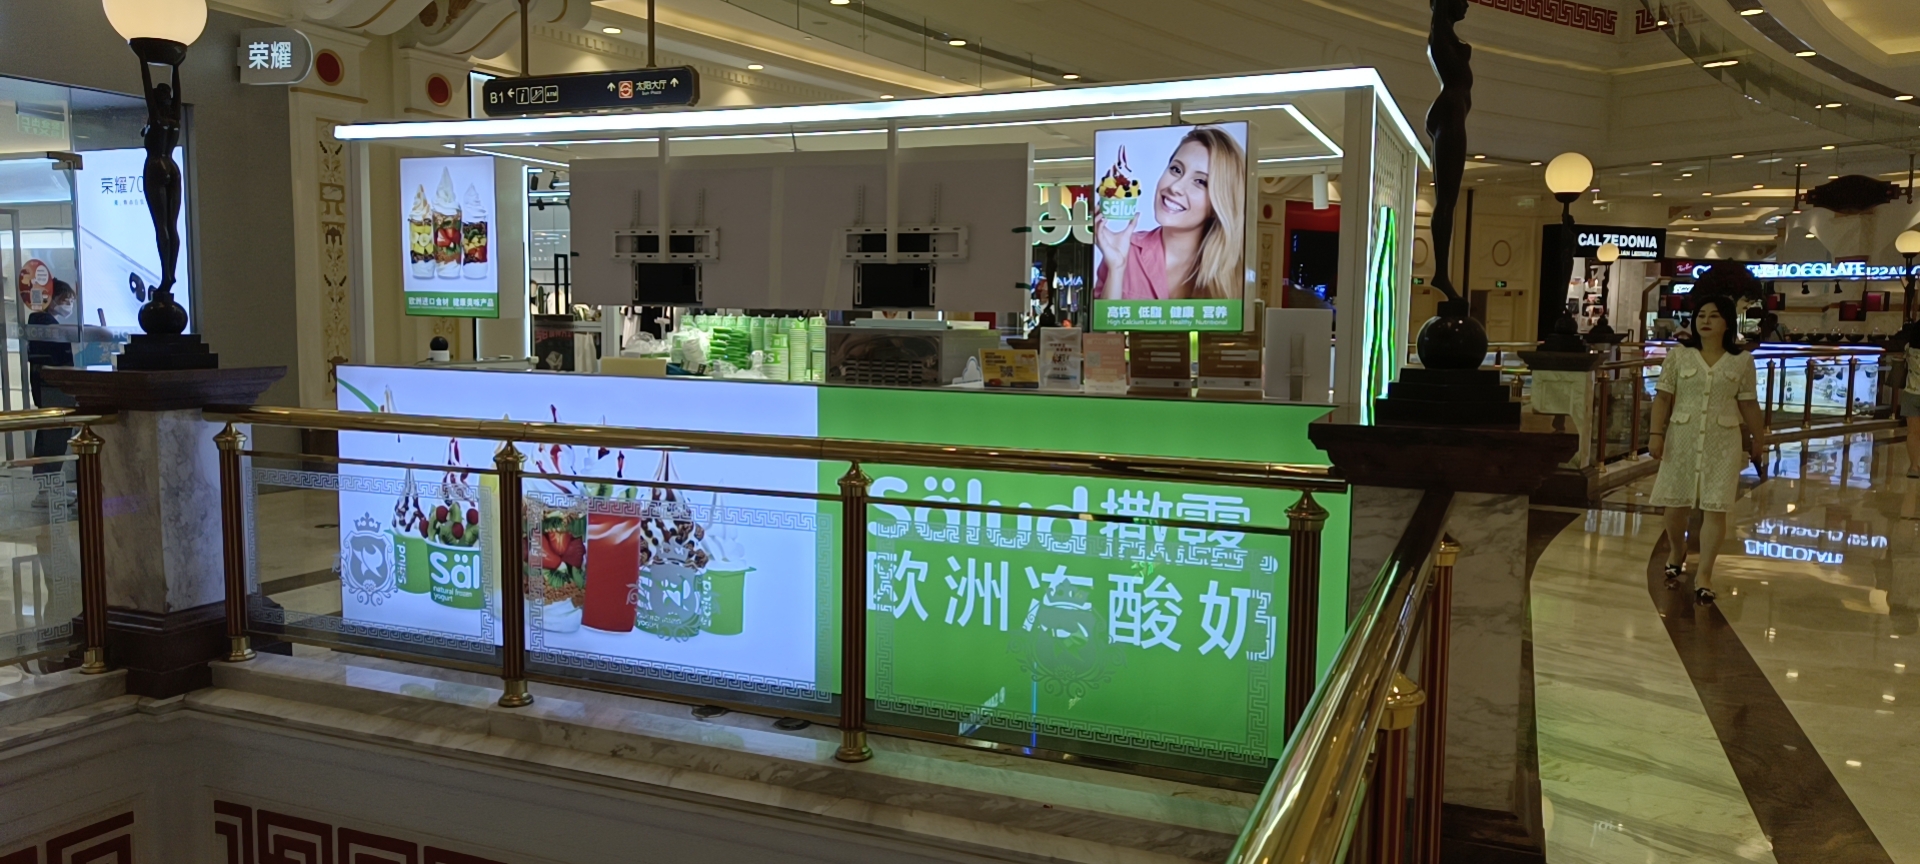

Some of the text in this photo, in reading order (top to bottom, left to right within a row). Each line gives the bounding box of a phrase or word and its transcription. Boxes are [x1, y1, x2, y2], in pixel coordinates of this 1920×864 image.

[248, 41, 292, 70] 荣耀
[635, 80, 668, 91] 太阳大厅
[489, 92, 505, 104] B1
[1578, 232, 1658, 249] CALZEDONIA
[1107, 306, 1131, 318] 高钙
[1170, 306, 1194, 318] 健康
[1202, 306, 1228, 318] 营养
[867, 476, 1088, 554] Sälud
[433, 586, 453, 595] natural
[434, 592, 453, 602] yogurt
